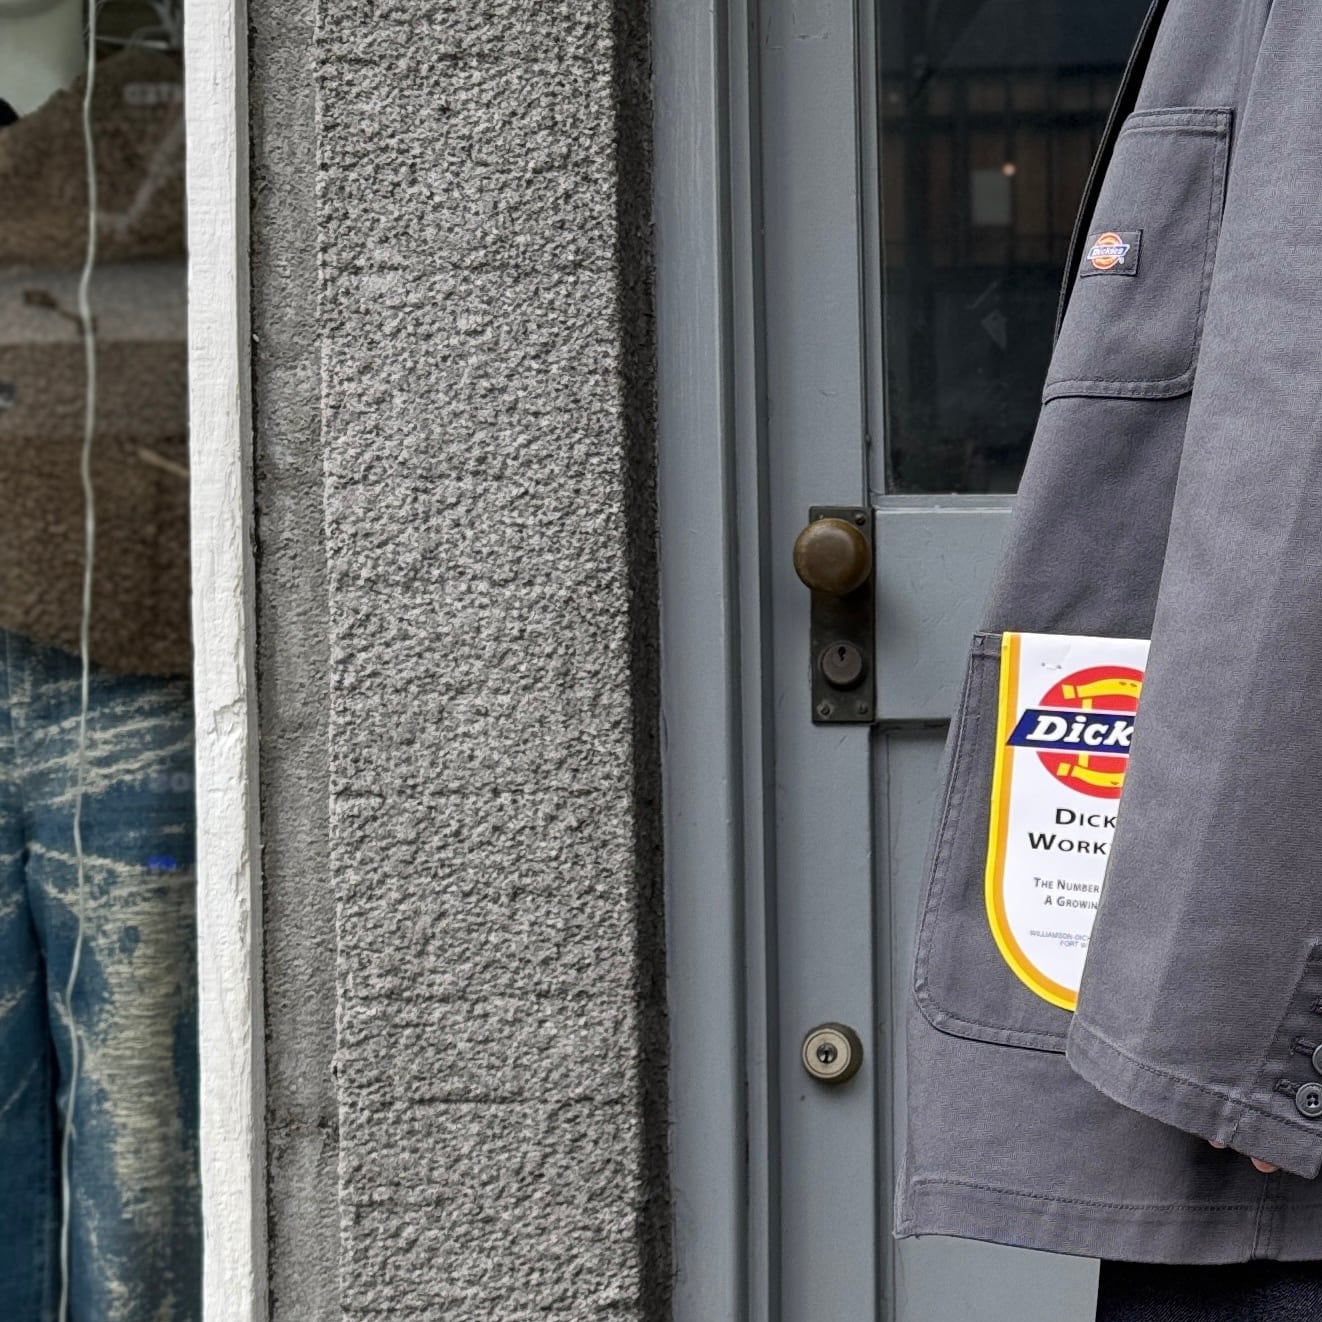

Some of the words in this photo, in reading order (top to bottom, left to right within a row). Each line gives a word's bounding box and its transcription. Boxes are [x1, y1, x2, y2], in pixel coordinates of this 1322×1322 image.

[1033, 877, 1054, 889] THE
[1057, 879, 1100, 893] NUMBER
[1044, 895, 1053, 905] A
